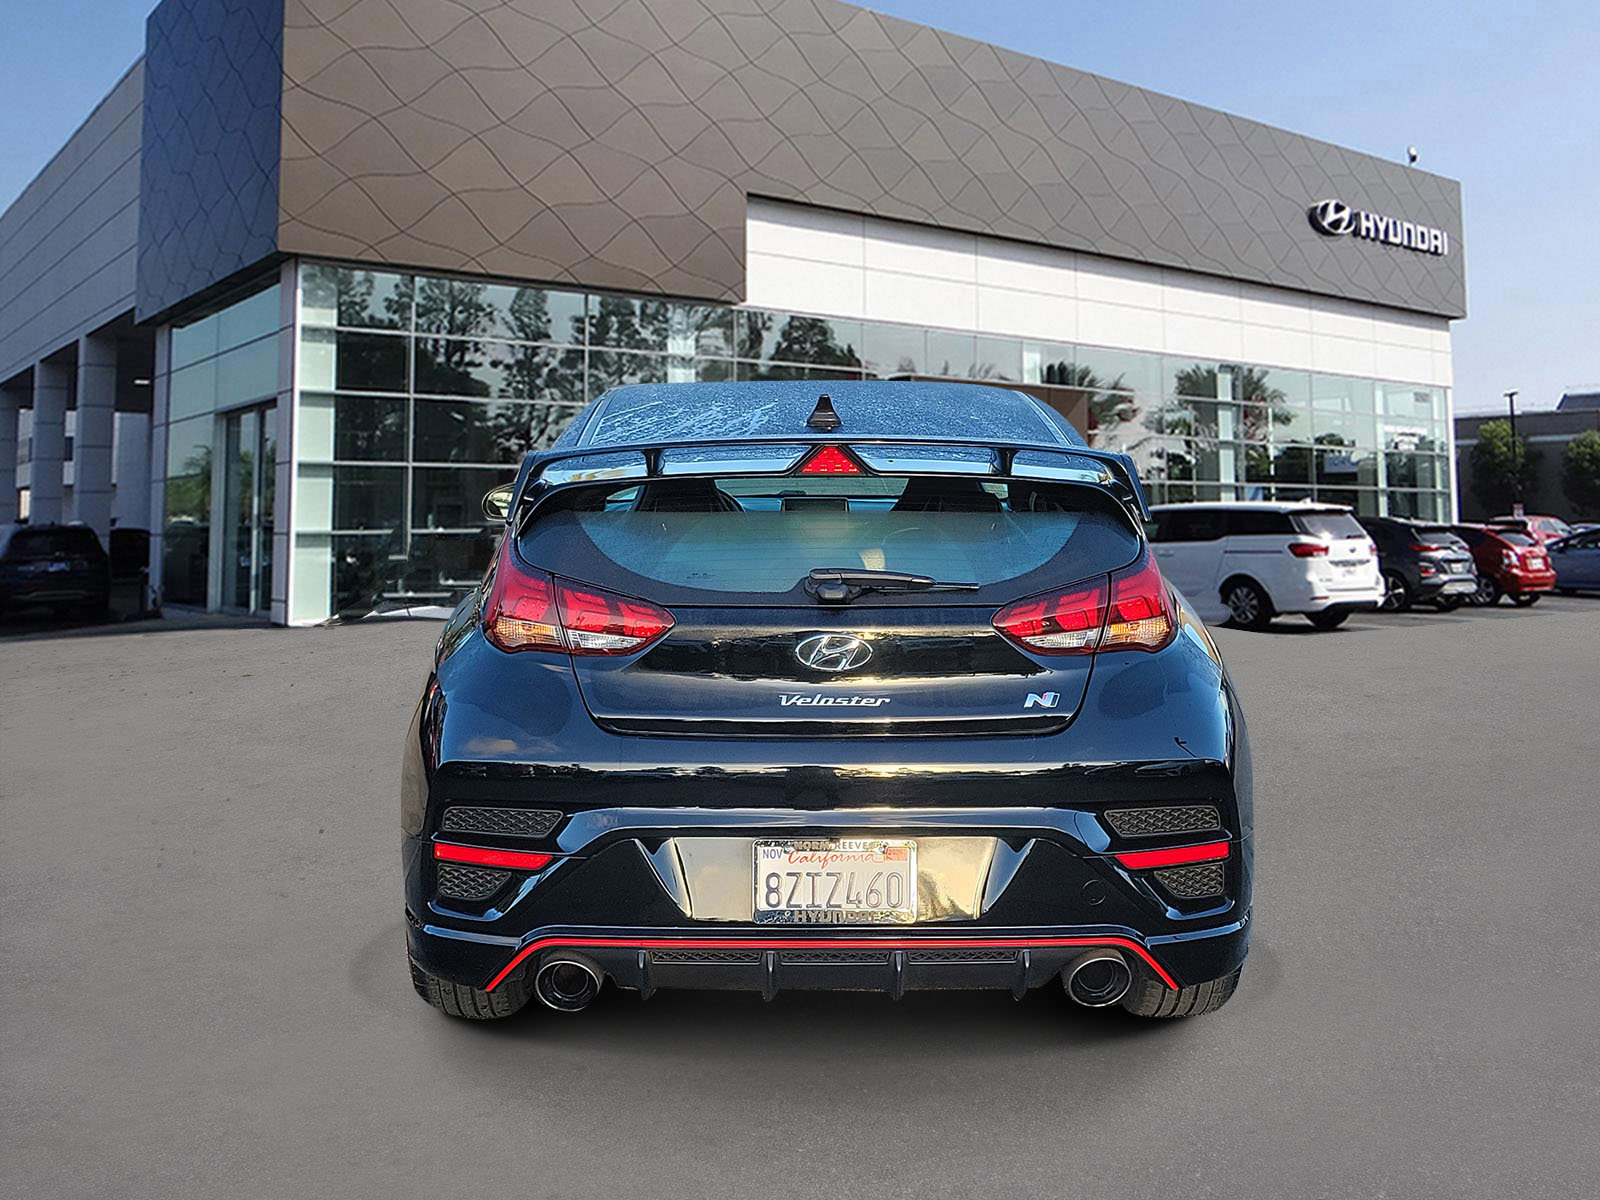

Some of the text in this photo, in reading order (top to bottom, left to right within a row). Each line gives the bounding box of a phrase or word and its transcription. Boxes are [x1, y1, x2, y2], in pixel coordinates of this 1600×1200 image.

[1360, 210, 1448, 255] HYUNDAI
[779, 694, 891, 707] Veloster
[762, 848, 783, 860] NOV
[788, 848, 885, 869] California
[765, 872, 903, 909] 8ZIZ460
